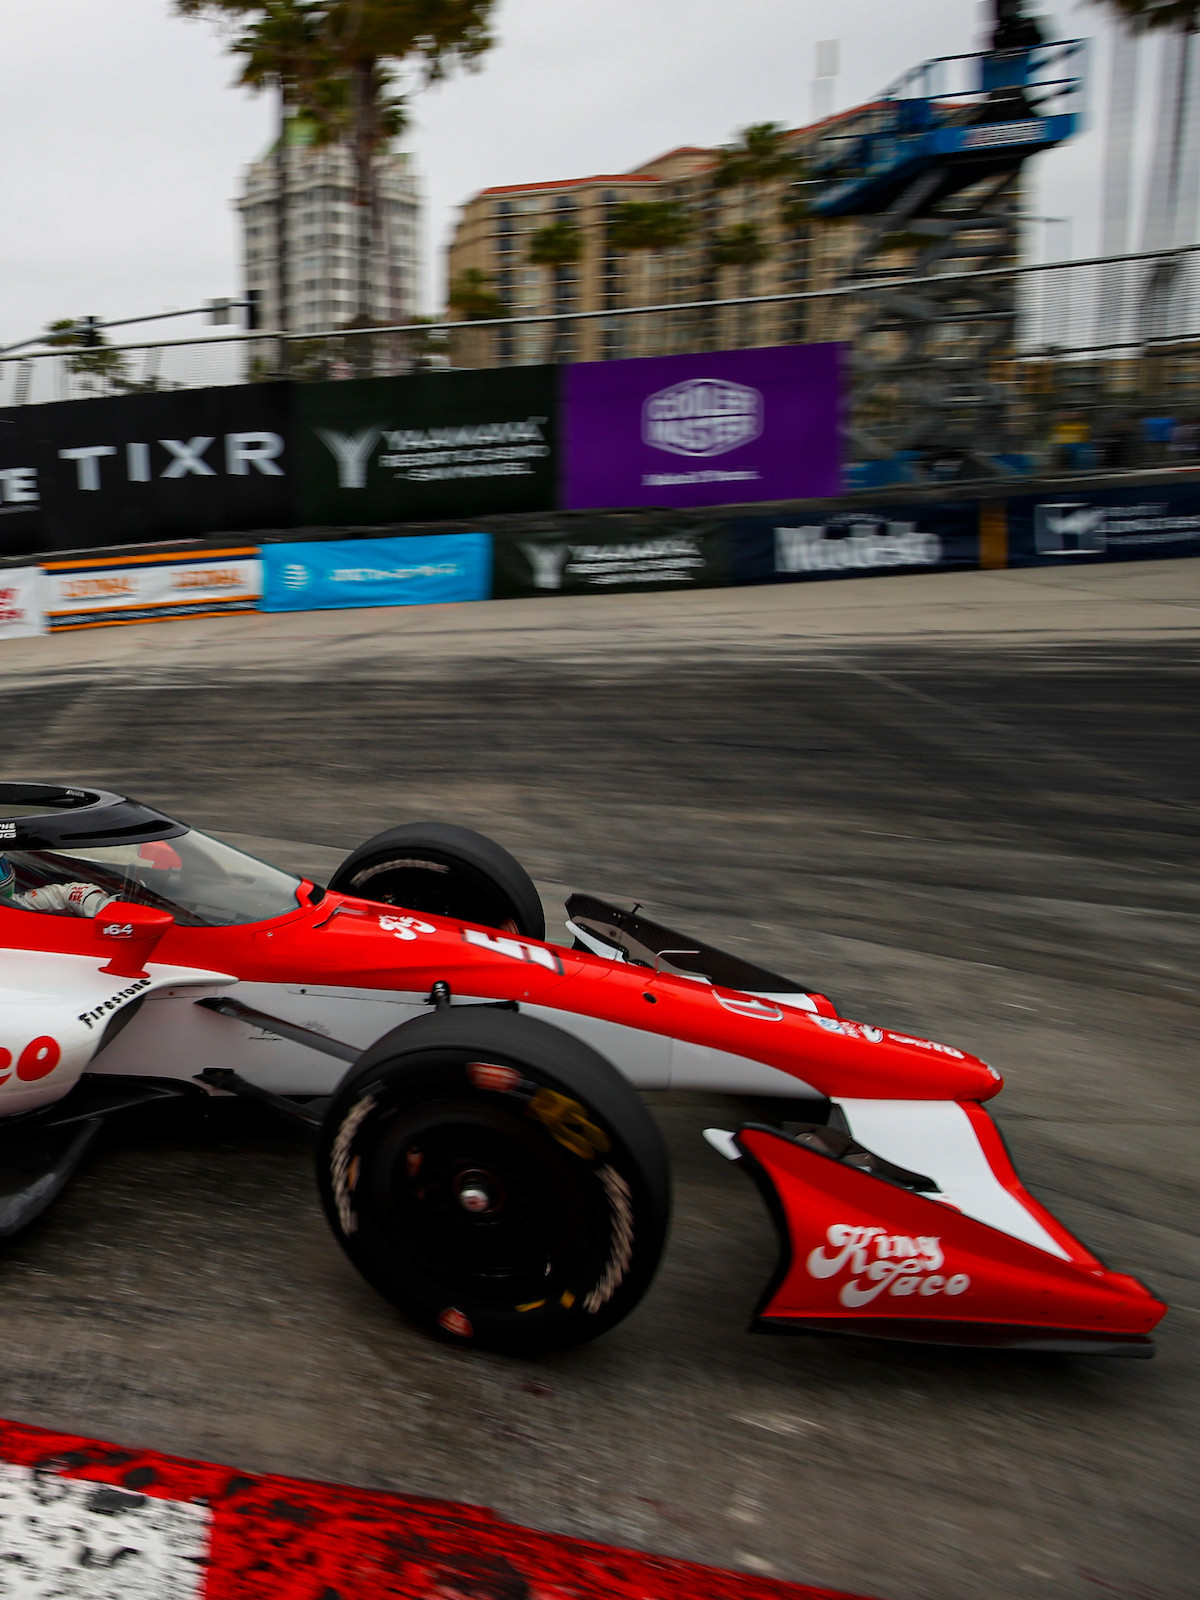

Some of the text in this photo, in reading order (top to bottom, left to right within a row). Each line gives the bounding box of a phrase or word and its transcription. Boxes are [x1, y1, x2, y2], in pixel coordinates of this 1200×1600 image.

[58, 431, 285, 491] TIXR
[77, 978, 152, 1030] Firestone
[806, 1223, 945, 1281] King
[839, 1259, 970, 1308] Taco
